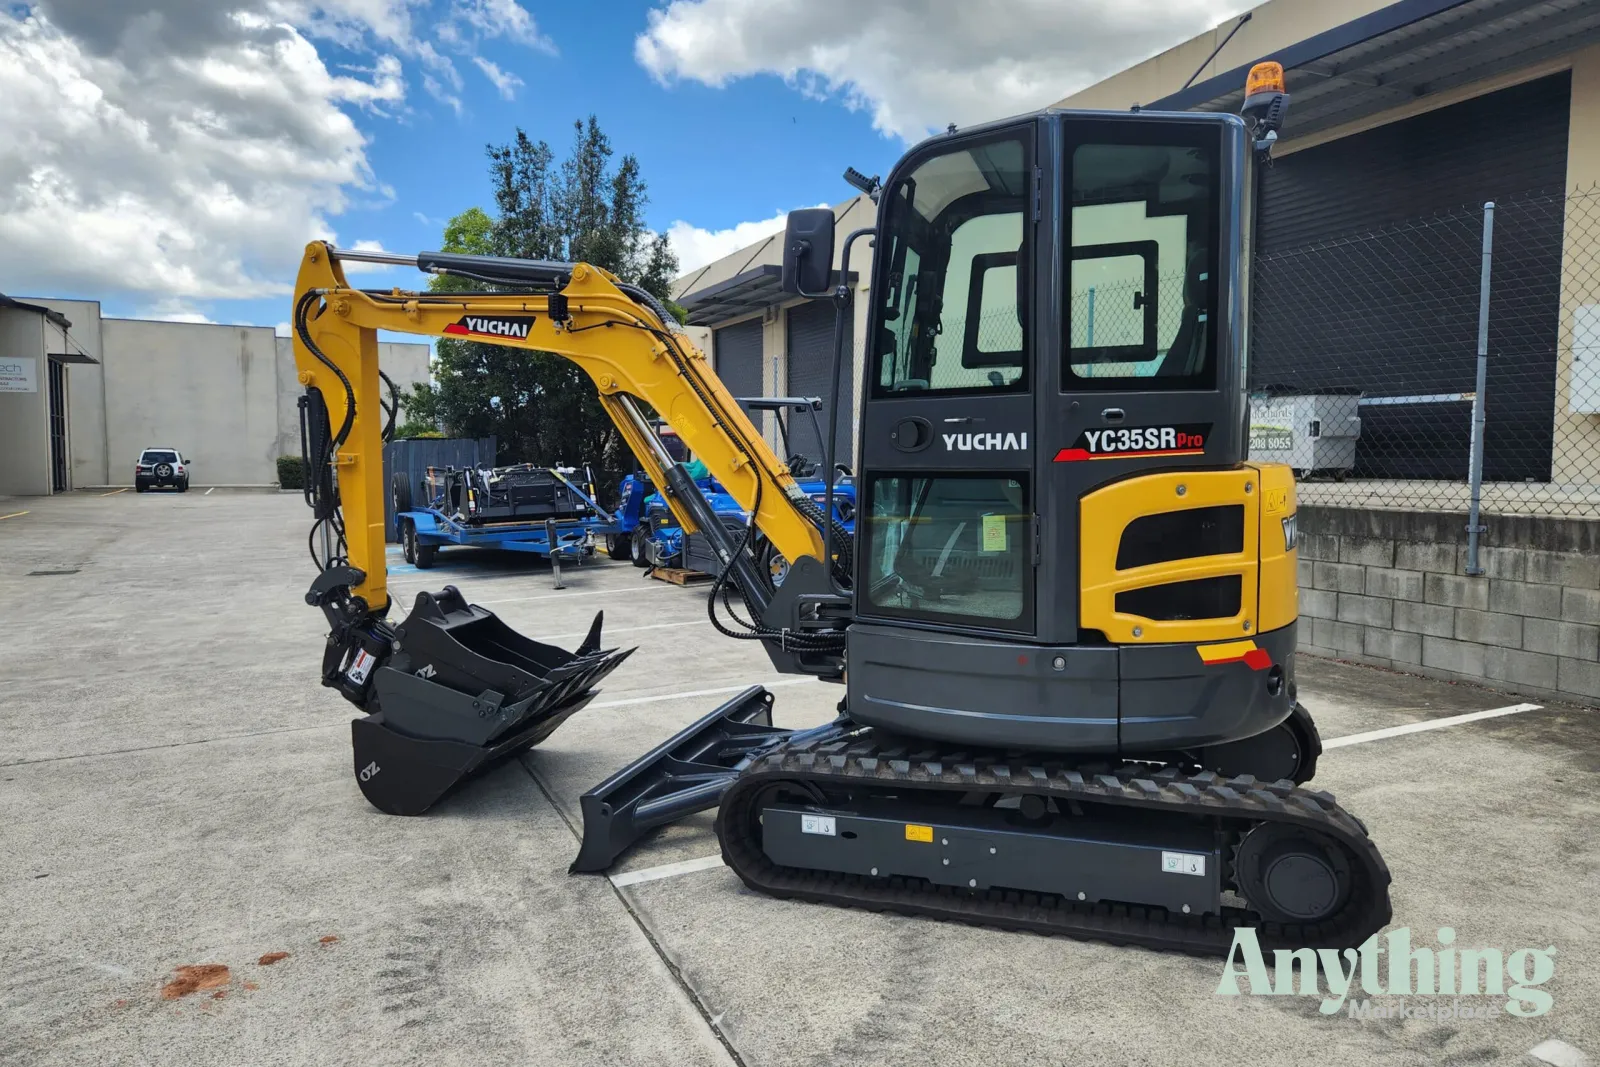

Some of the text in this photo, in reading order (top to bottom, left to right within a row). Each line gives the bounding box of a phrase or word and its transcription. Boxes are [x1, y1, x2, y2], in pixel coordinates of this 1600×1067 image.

[466, 317, 528, 337] YUCHAI
[942, 432, 1028, 451] YUCHAI
[359, 760, 381, 782] OZ
